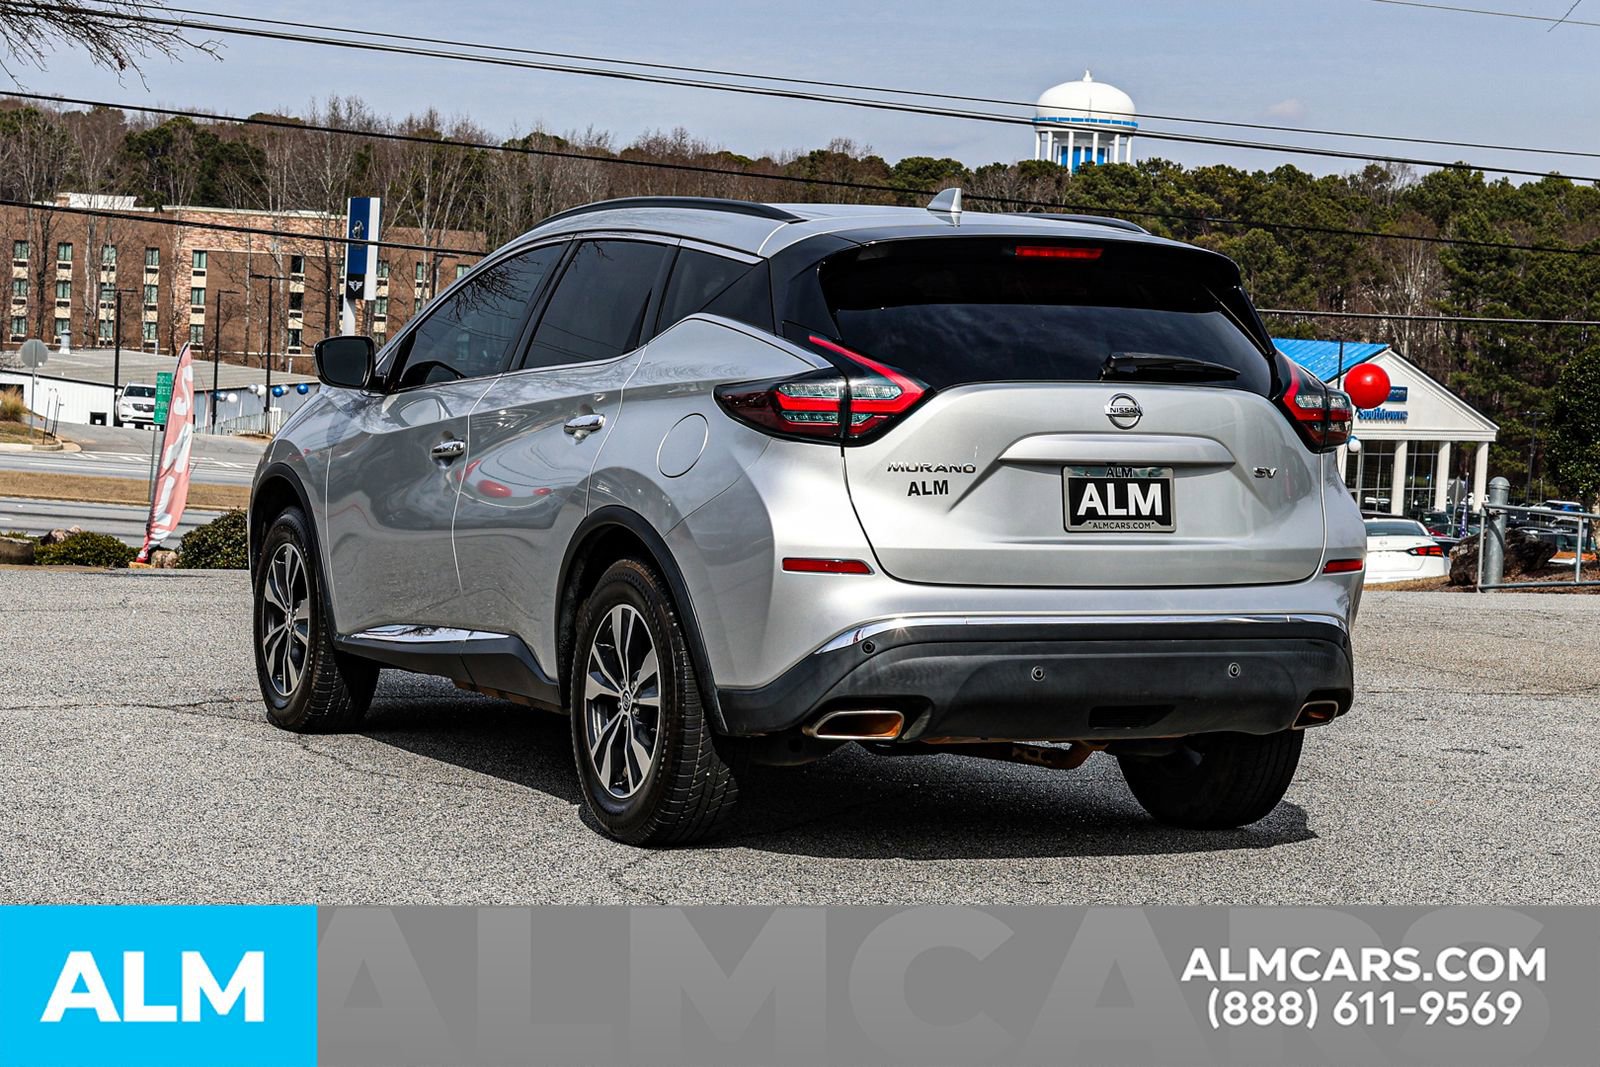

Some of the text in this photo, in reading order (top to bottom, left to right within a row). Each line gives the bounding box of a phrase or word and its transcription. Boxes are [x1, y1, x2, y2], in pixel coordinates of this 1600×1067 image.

[887, 463, 977, 474] MURANO
[1106, 467, 1133, 478] ALM
[1253, 467, 1277, 478] SV
[907, 480, 949, 496] ALM
[1077, 483, 1163, 515] ALM
